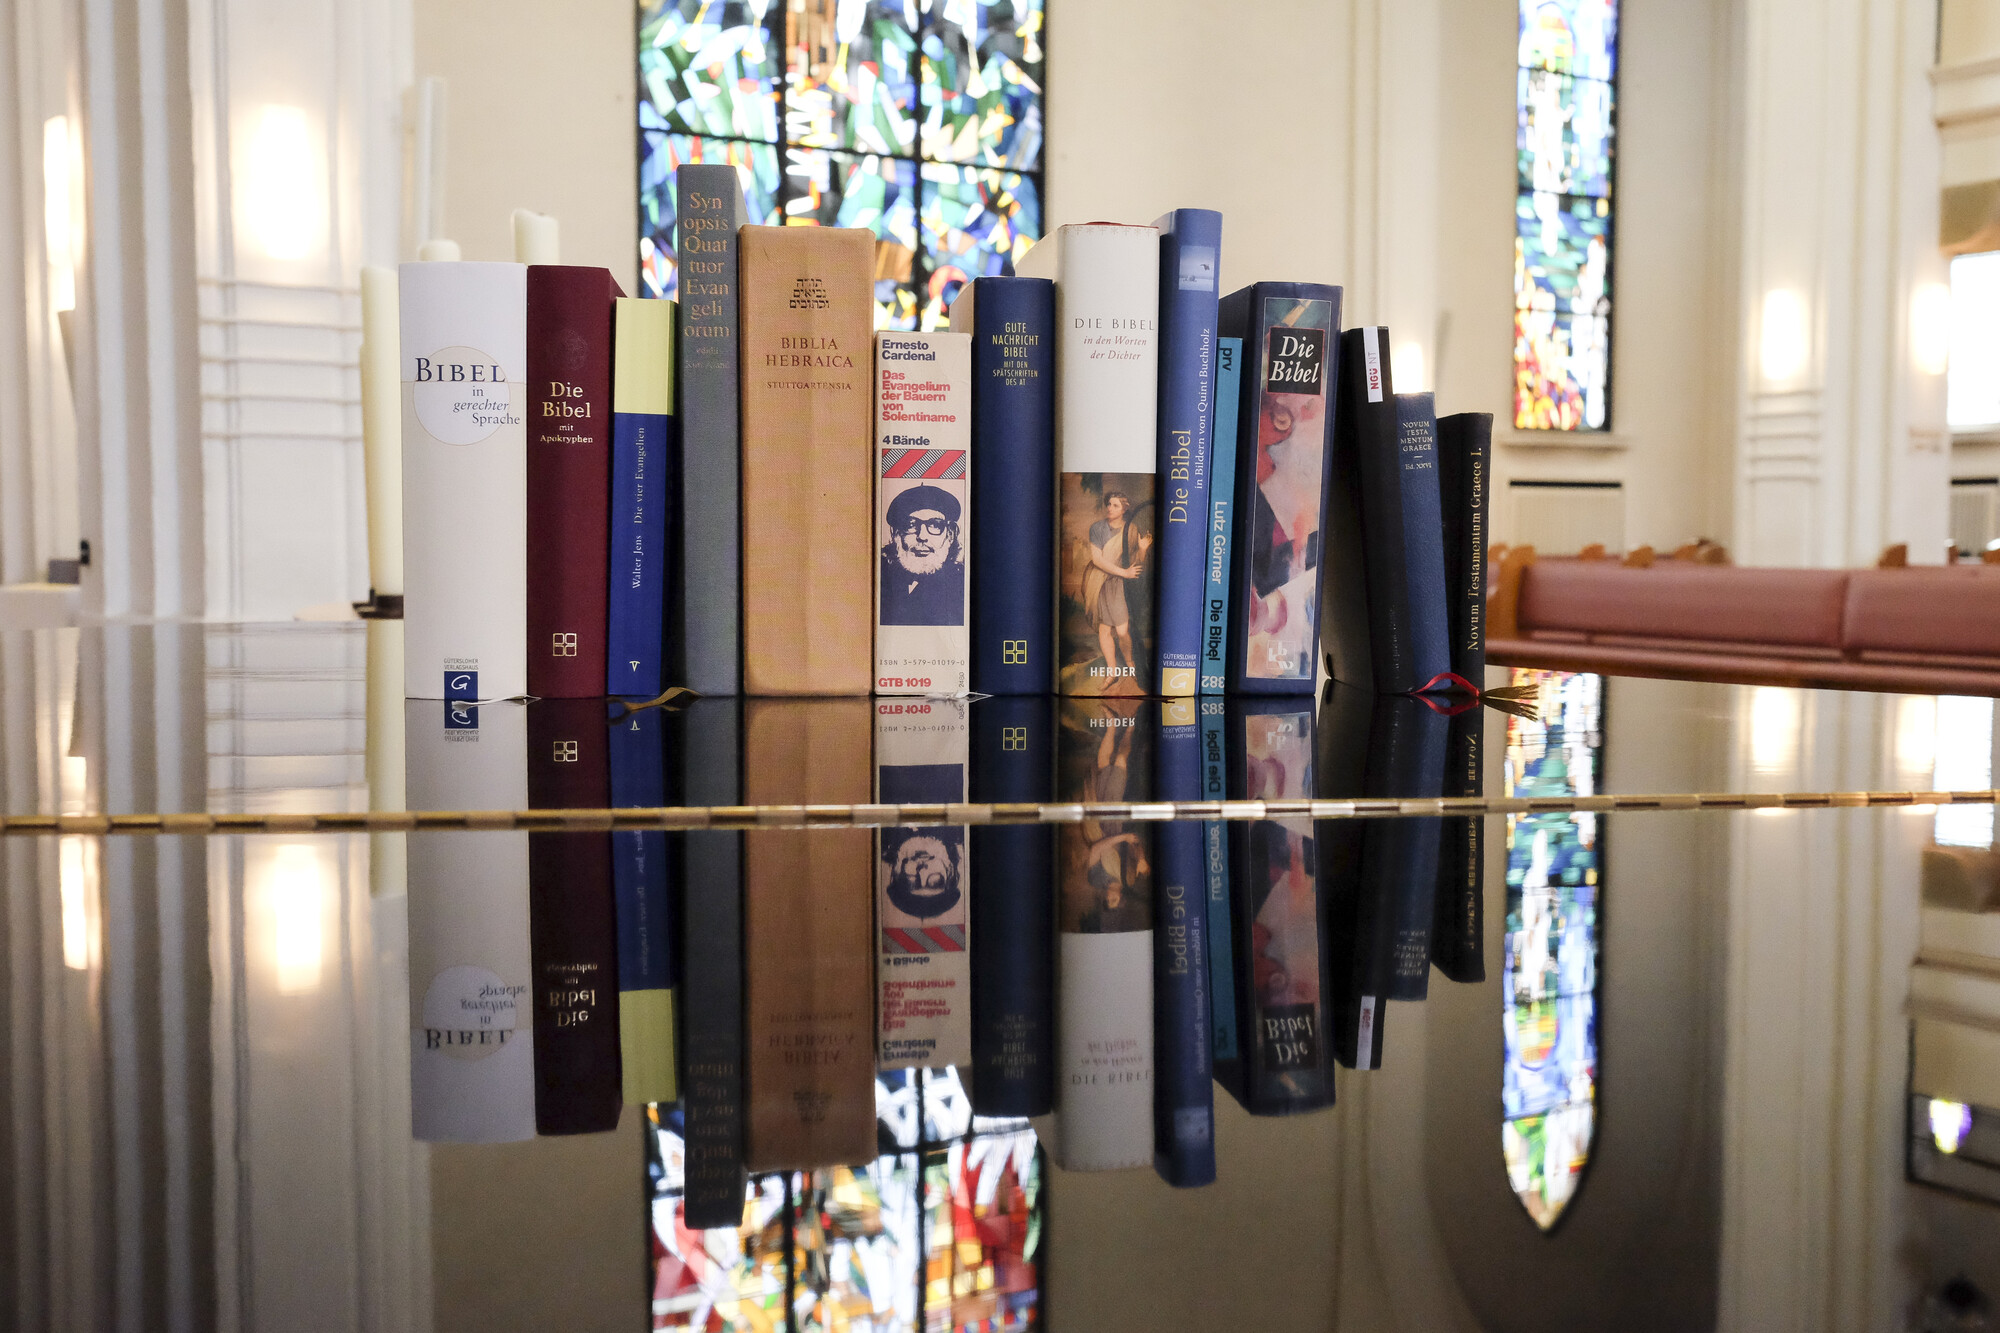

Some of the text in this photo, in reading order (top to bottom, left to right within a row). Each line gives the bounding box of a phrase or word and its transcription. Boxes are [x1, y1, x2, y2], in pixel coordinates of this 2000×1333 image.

[690, 192, 722, 213] Syn
[684, 214, 729, 234] opsis
[684, 235, 727, 254] Quat
[689, 260, 725, 274] tuor
[686, 278, 729, 295] Evan
[690, 298, 722, 320] geli
[684, 325, 730, 337] orum
[1005, 322, 1027, 333] GUTE
[1075, 318, 1155, 331] DIE BIBEL
[781, 337, 838, 350] BIBLIA
[882, 339, 929, 350] Ernesto
[992, 334, 1039, 346] NACHRICHT
[1083, 335, 1147, 346] in den Worten
[1003, 346, 1028, 358] BIBEL
[1278, 335, 1315, 359] Die
[765, 354, 854, 368] HEBRAICA
[882, 350, 936, 361] Cardenal
[1090, 350, 1141, 360] der Dichter
[415, 357, 506, 382] BIBEL
[1003, 360, 1028, 368] MIT DEN
[1367, 351, 1380, 390] NGÜ NT
[882, 370, 905, 381] Das
[1269, 360, 1320, 384] Bibel
[767, 381, 852, 390] STUTTGARTENSIA
[882, 381, 951, 393] Evangelium
[1005, 378, 1026, 386] DES AT
[472, 385, 484, 397] in
[550, 381, 583, 398] Die
[881, 391, 946, 401] der Bauern
[453, 398, 509, 413] gerechter
[542, 401, 592, 418] Bibel
[882, 403, 904, 411] von
[1194, 328, 1210, 489] in Bildern von Quint Buchholz
[472, 412, 521, 426] Sprache
[882, 411, 956, 423] Solentiname
[559, 424, 574, 432] mit
[1402, 420, 1430, 429] NOVUM
[1406, 428, 1428, 436] TESTA
[540, 435, 593, 444] Apokryphen
[882, 435, 930, 446] 4 Bände
[1400, 436, 1433, 445] MENTUM
[1402, 443, 1432, 452] GRAECE
[1169, 429, 1191, 524] Die Bibel
[1470, 461, 1481, 508] Graece
[632, 427, 646, 589] Walter Jens Die vier Evangelien
[1214, 501, 1228, 532] Lutz
[1211, 534, 1226, 584] Görner
[1467, 513, 1481, 599] Testamentum
[1210, 599, 1223, 622] Die
[1467, 604, 1479, 651] Novum
[1090, 666, 1136, 677] HERDER
[878, 677, 932, 687] GTB 1019
[1201, 675, 1225, 689] 382
